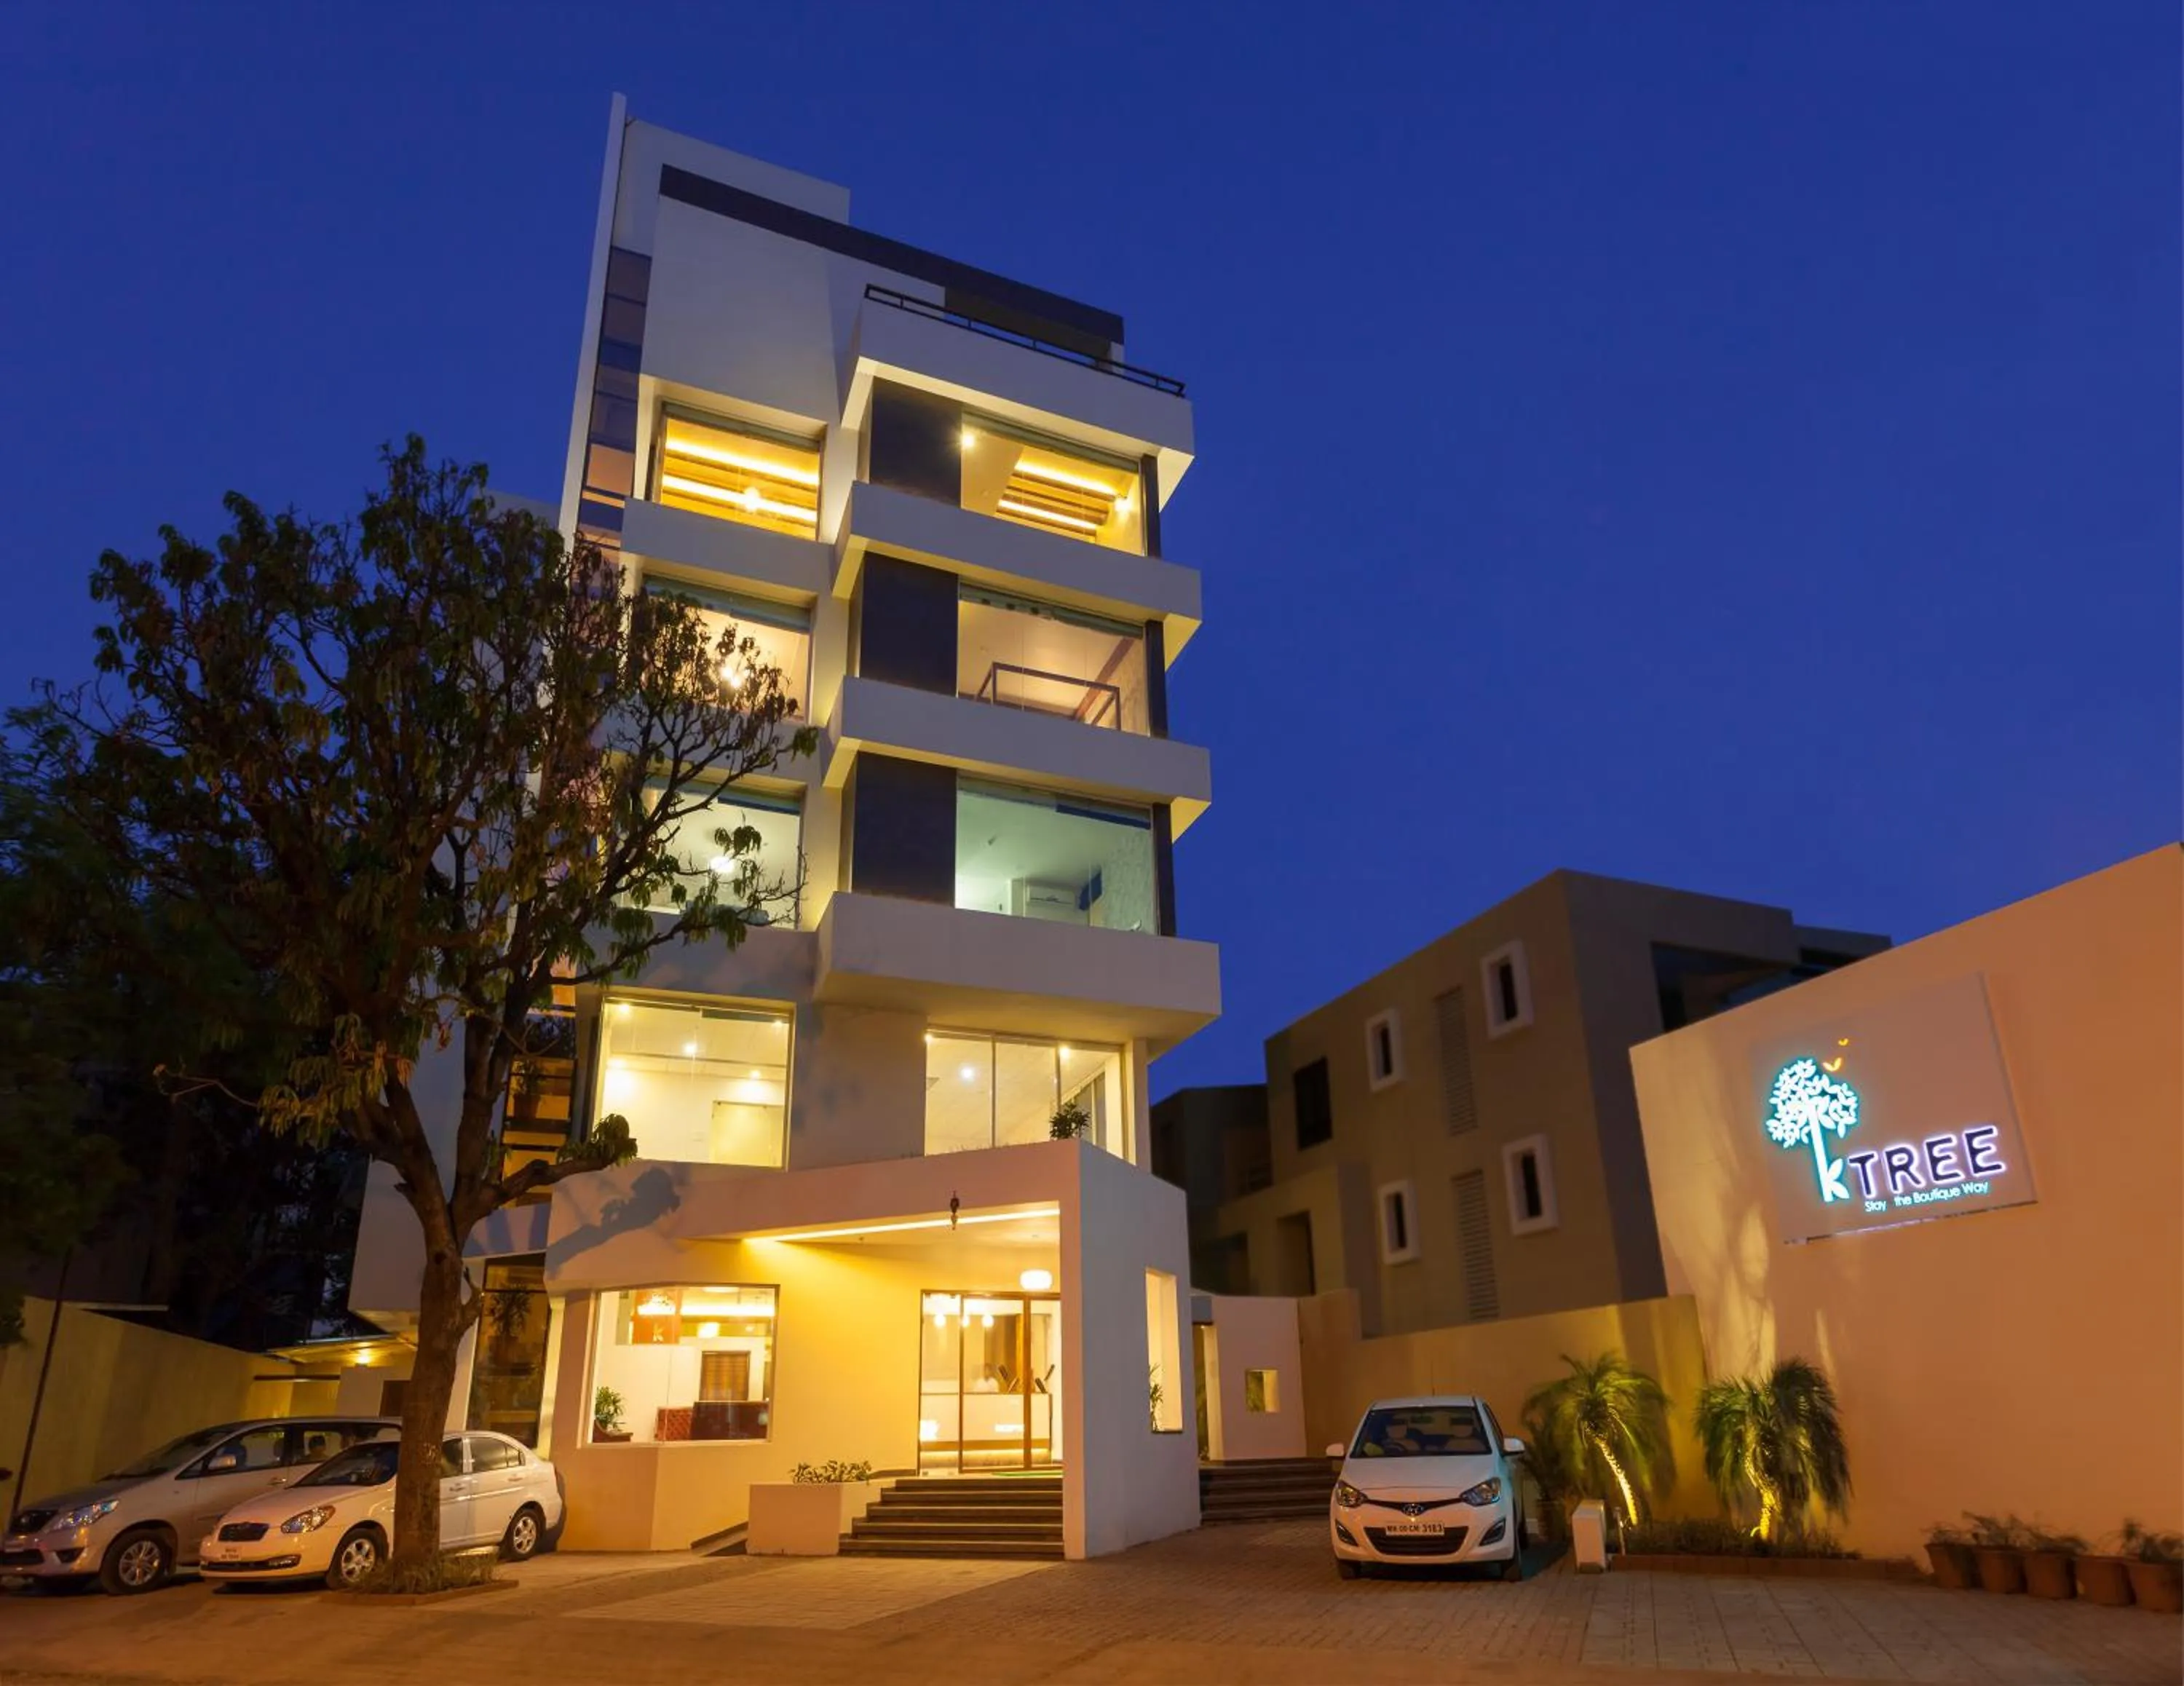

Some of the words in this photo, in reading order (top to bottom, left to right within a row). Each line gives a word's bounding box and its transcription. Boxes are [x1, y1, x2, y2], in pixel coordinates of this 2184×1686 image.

[1864, 1200, 1887, 1212] Stay
[1894, 1194, 1912, 1206] the
[1912, 1186, 1961, 1203] Boutique
[1961, 1181, 1989, 1195] Way
